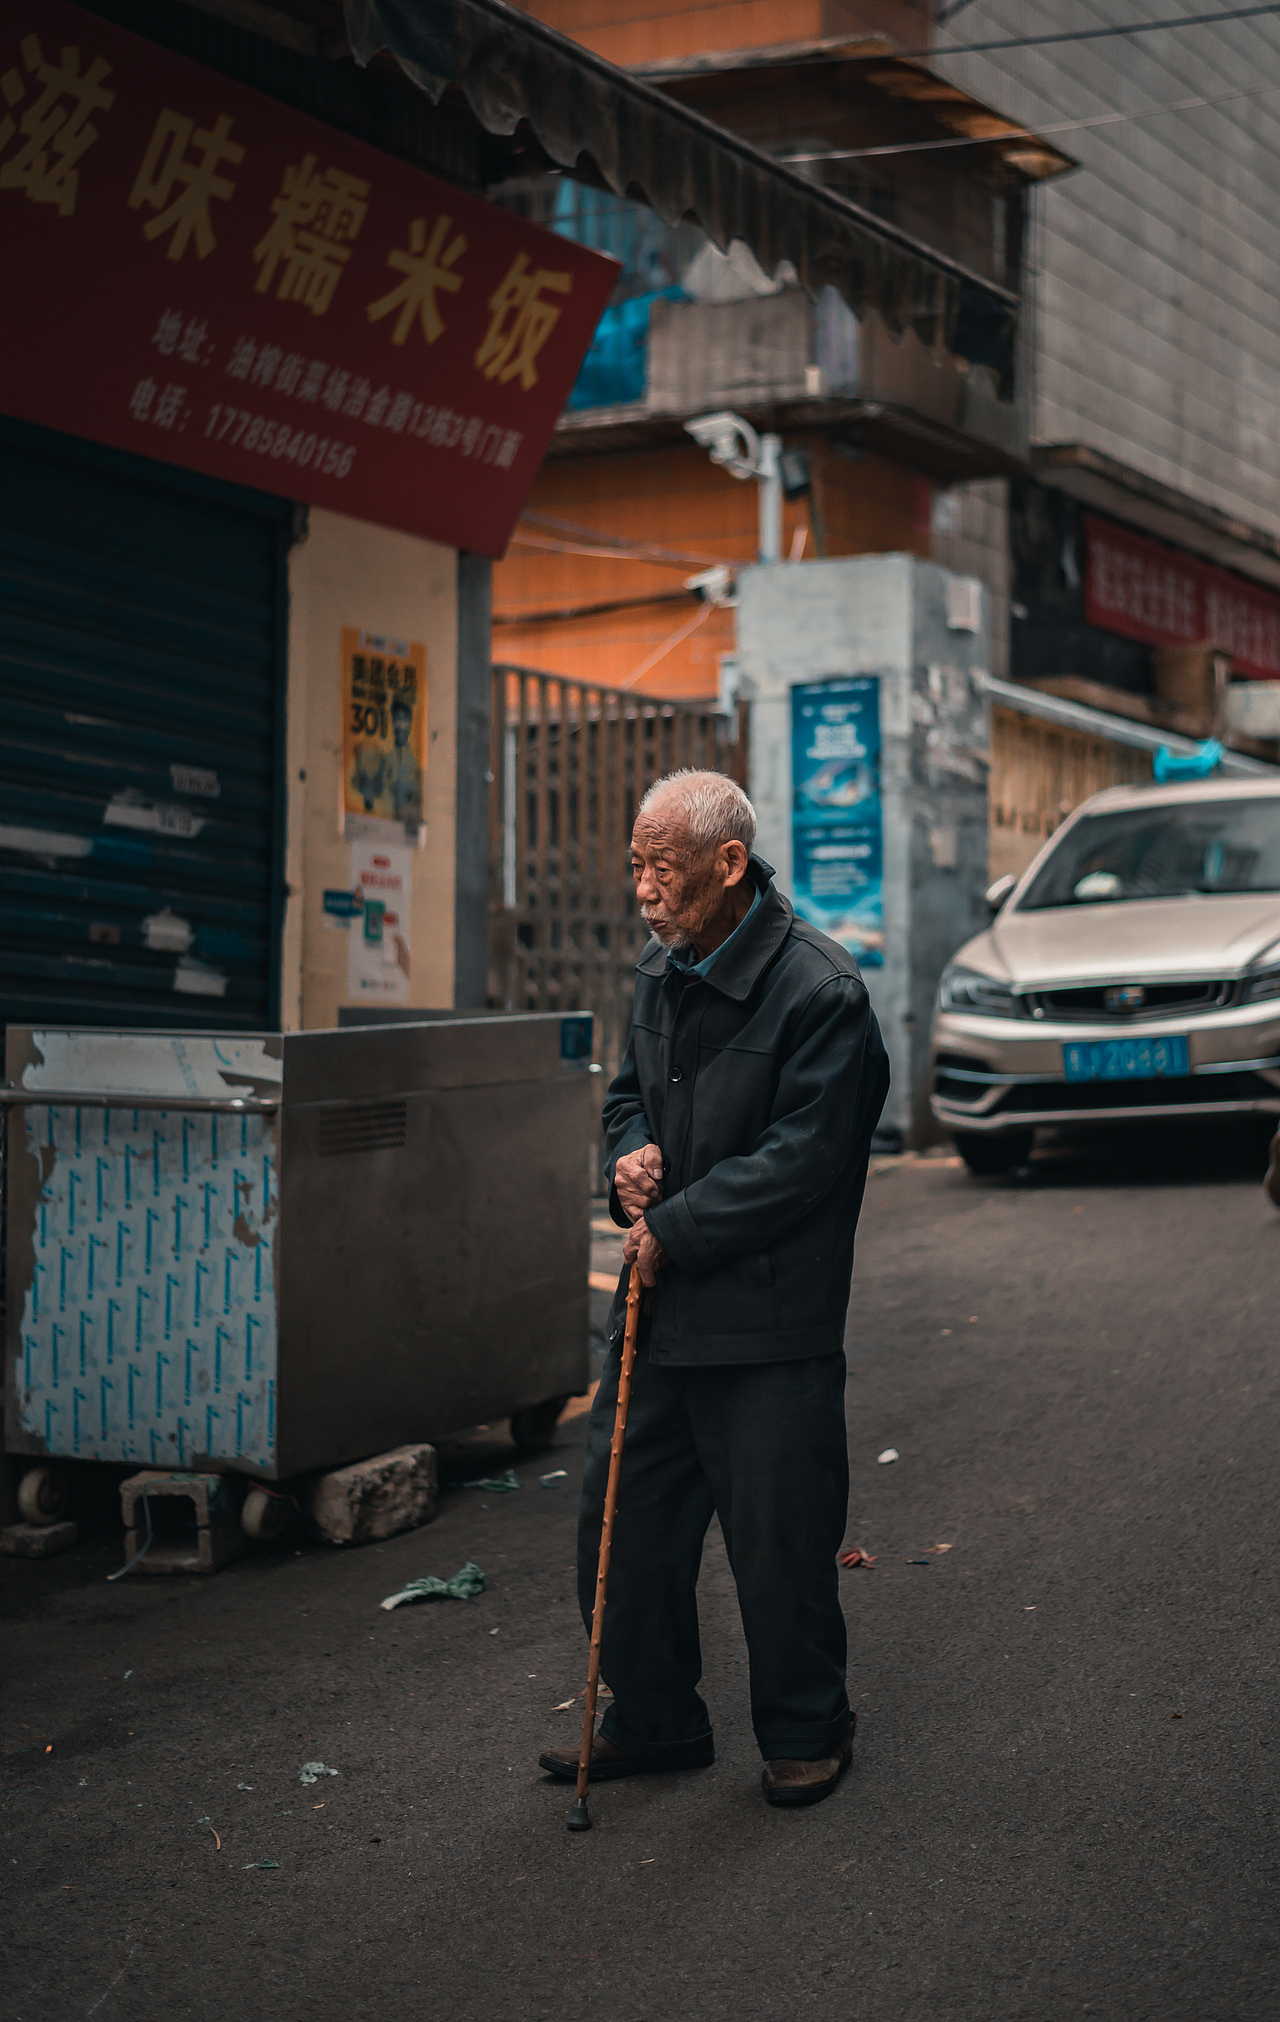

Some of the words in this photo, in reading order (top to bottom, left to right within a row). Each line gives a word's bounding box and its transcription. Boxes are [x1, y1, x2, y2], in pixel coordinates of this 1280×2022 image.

[0, 32, 572, 390] 滋味糯米饭
